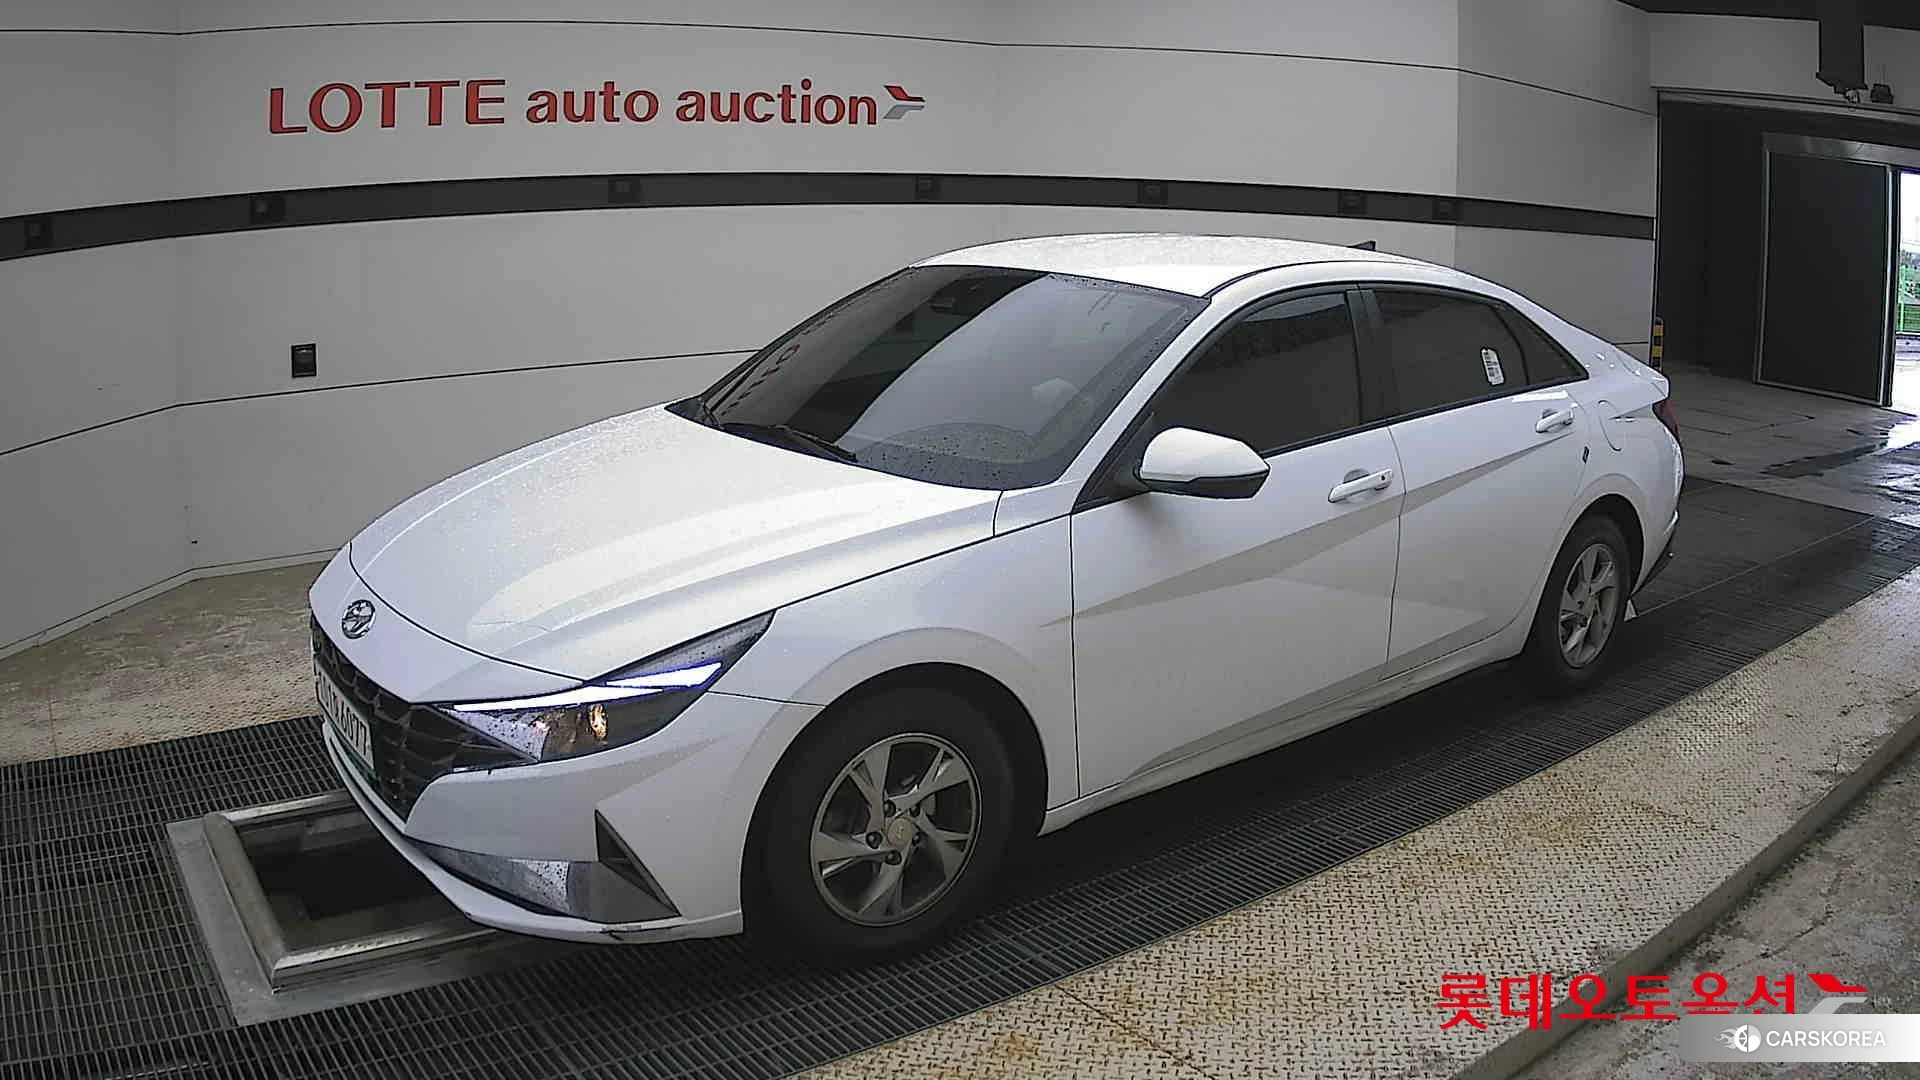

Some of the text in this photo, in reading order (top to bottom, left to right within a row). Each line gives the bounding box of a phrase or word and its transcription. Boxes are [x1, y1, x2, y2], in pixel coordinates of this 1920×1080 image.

[270, 78, 878, 134] LOTTE auto auction
